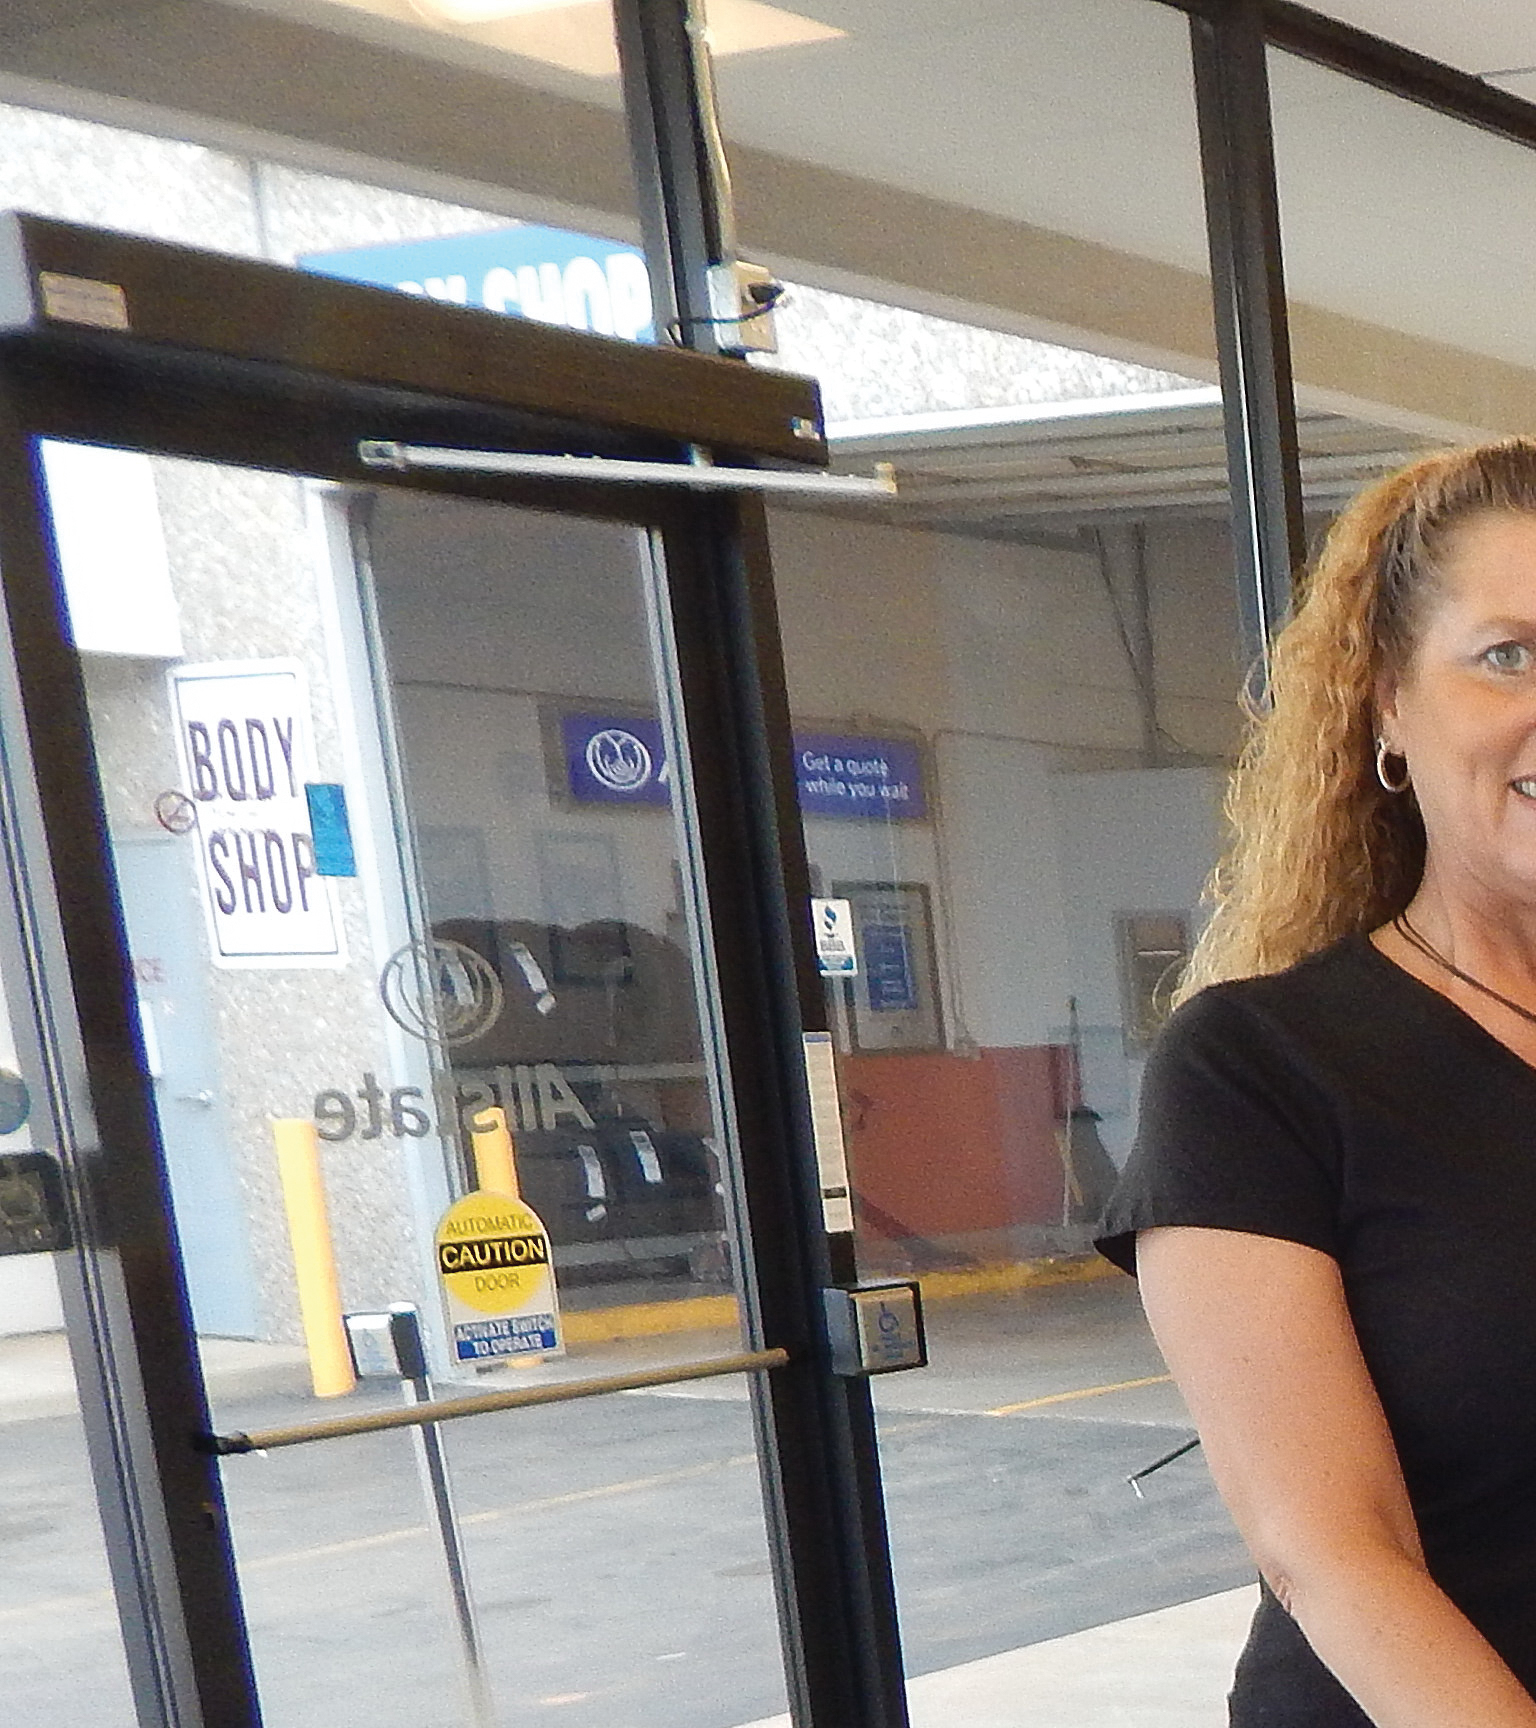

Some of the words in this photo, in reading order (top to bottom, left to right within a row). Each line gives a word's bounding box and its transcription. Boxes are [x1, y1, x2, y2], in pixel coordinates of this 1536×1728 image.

[188, 716, 298, 802] BODY
[802, 750, 830, 772] Get
[834, 757, 844, 772] a
[846, 757, 889, 779] quote
[208, 827, 316, 915] SHOP
[446, 1213, 534, 1235] AUTOMATIC
[442, 1237, 545, 1269] CAUTION
[475, 1272, 520, 1292] DOOR
